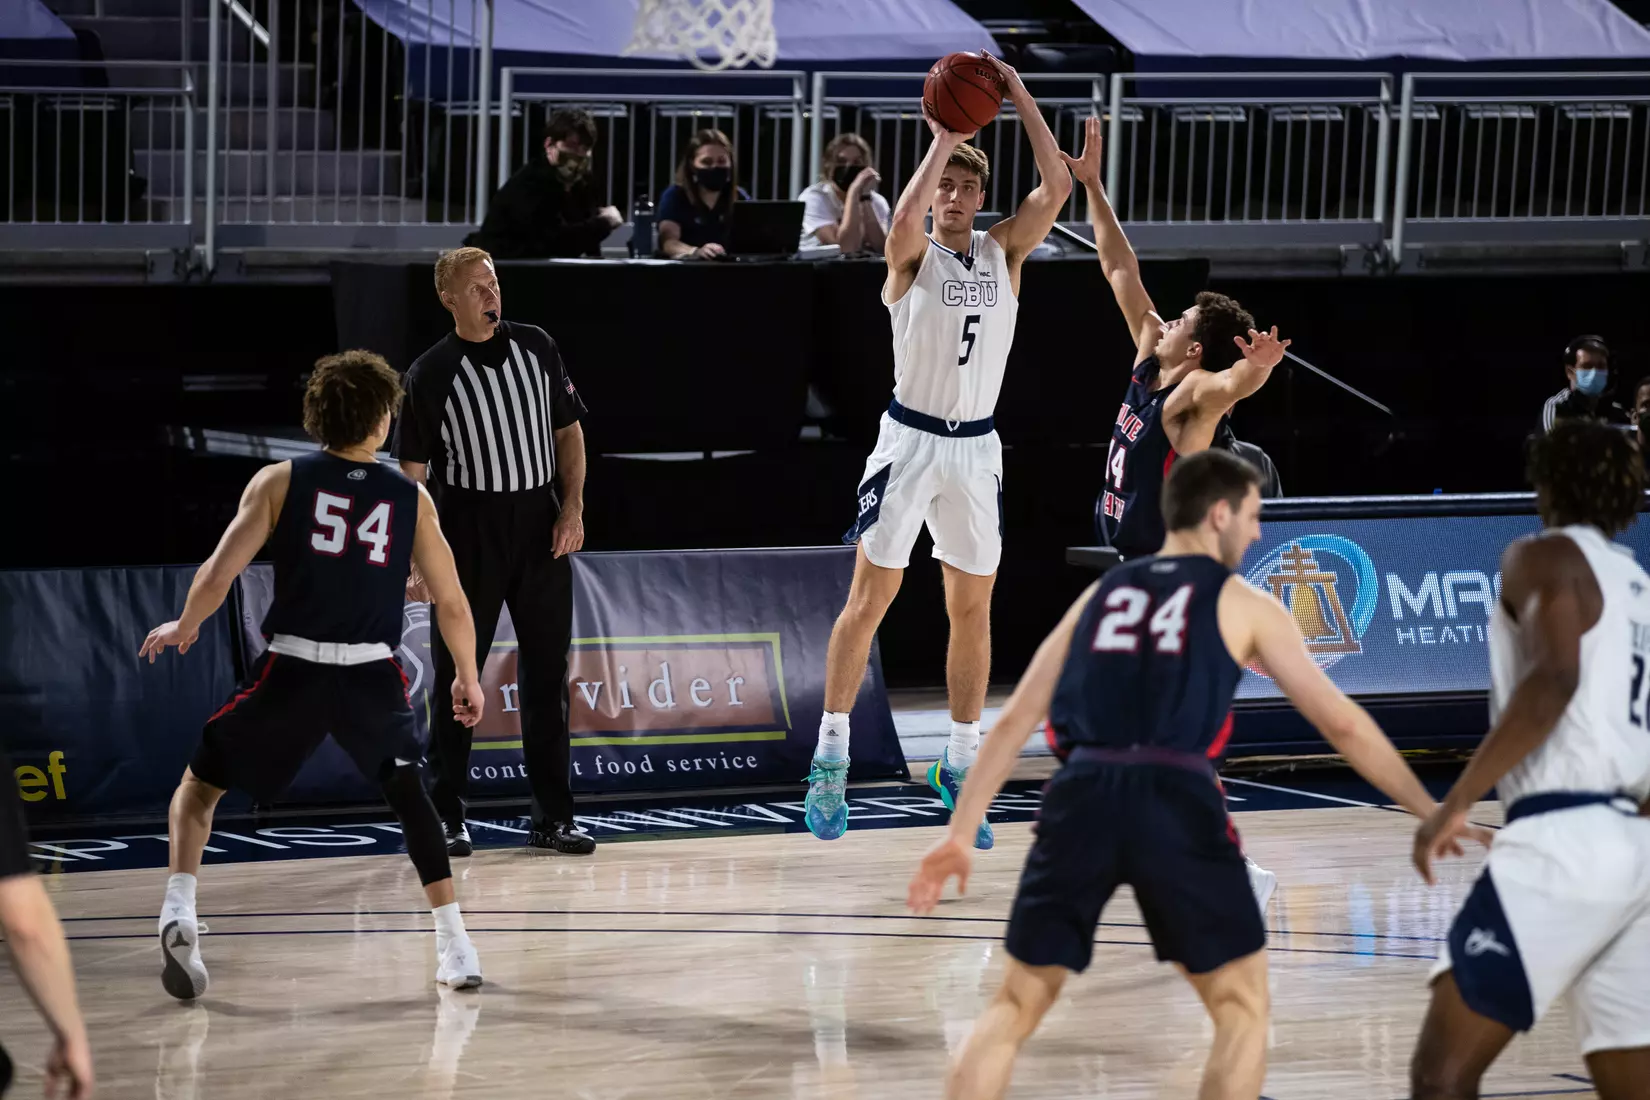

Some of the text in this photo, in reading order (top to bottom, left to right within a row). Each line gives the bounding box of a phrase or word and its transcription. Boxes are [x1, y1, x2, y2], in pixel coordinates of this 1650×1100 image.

[942, 280, 998, 307] CBU
[958, 314, 981, 366] 5
[310, 488, 394, 567] 54
[859, 487, 878, 517] ERS
[1091, 583, 1194, 655] 24
[500, 661, 746, 712] rvider
[14, 750, 67, 802] ef
[470, 752, 758, 780] contt food service
